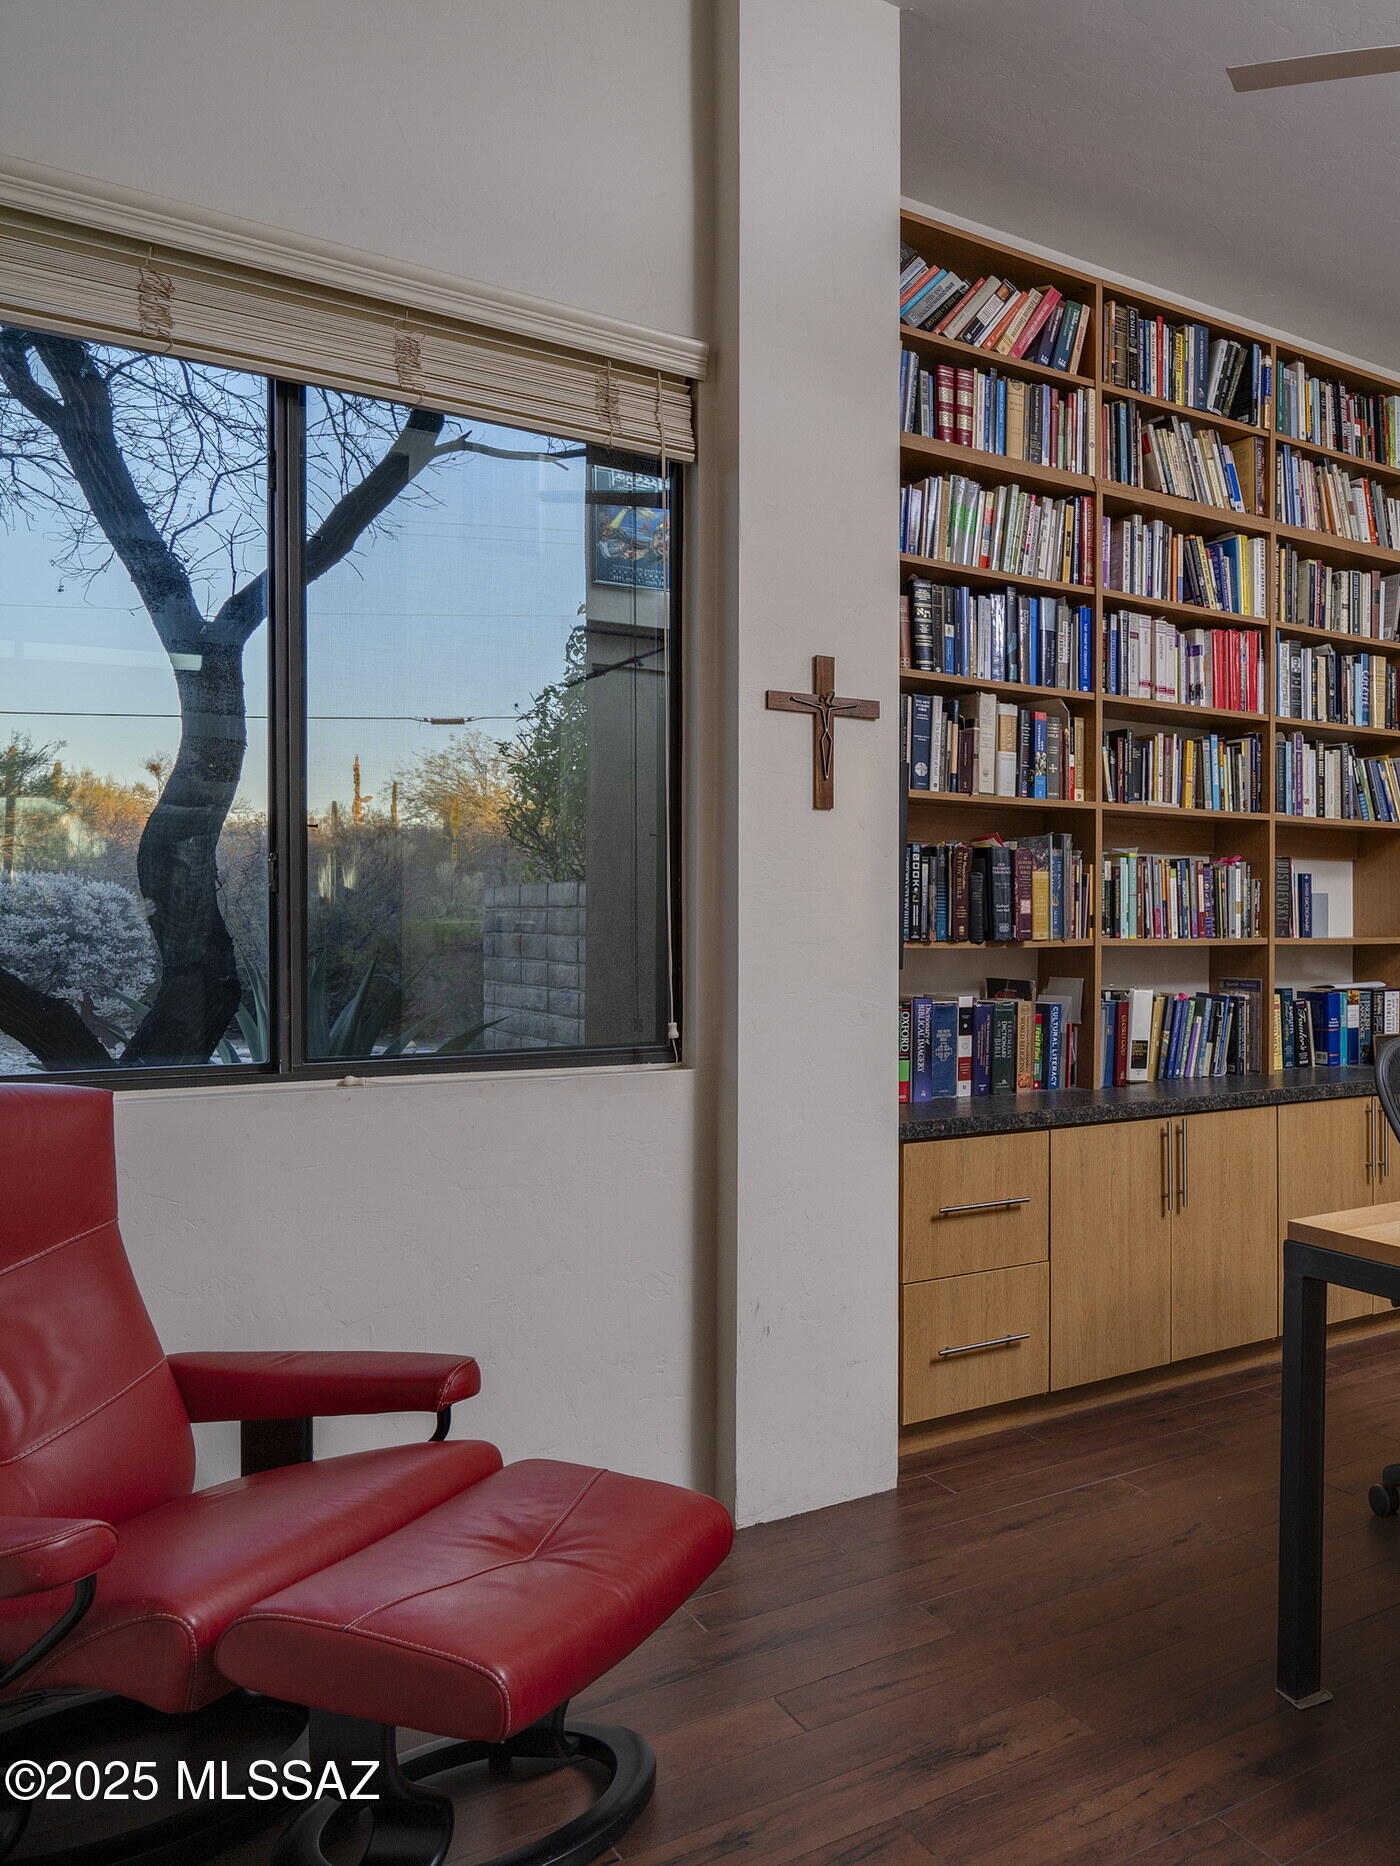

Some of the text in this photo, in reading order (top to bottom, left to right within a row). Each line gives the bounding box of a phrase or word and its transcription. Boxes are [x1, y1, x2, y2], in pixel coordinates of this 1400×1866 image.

[1277, 861, 1289, 922] DOSTOEVSKY
[901, 1011, 910, 1052] OXFORD
[917, 1003, 925, 1072] BIBLICAL IMAGERY
[924, 1003, 932, 1038] Dictionary
[1298, 1008, 1307, 1051] Fowler's
[1050, 1049, 1058, 1086] LITERACY
